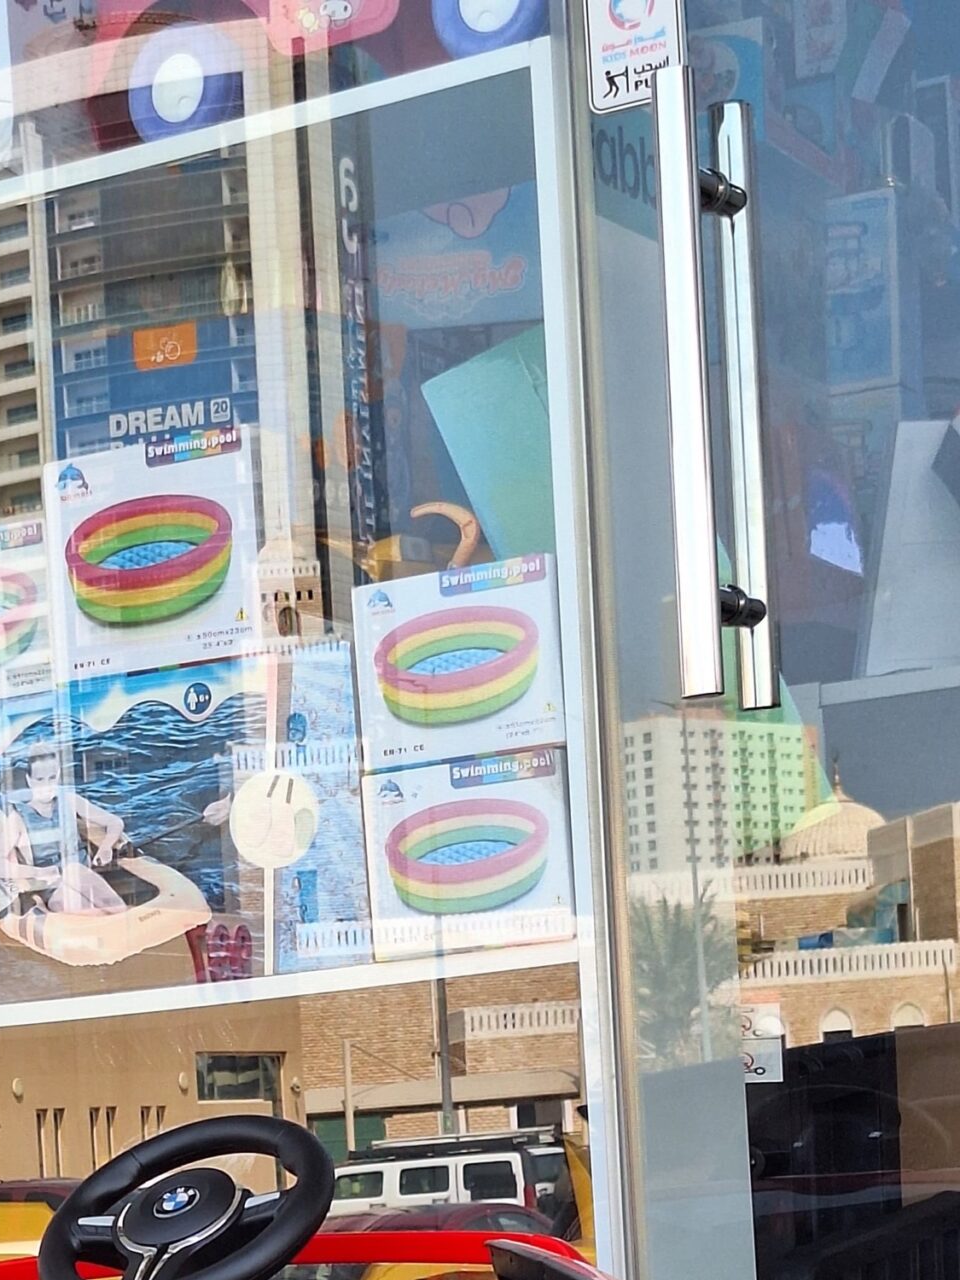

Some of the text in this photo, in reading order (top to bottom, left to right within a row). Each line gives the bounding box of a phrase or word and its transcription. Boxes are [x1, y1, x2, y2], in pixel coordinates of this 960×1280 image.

[602, 41, 667, 65] KIDS MOON
[109, 400, 230, 438] DREAM 20
